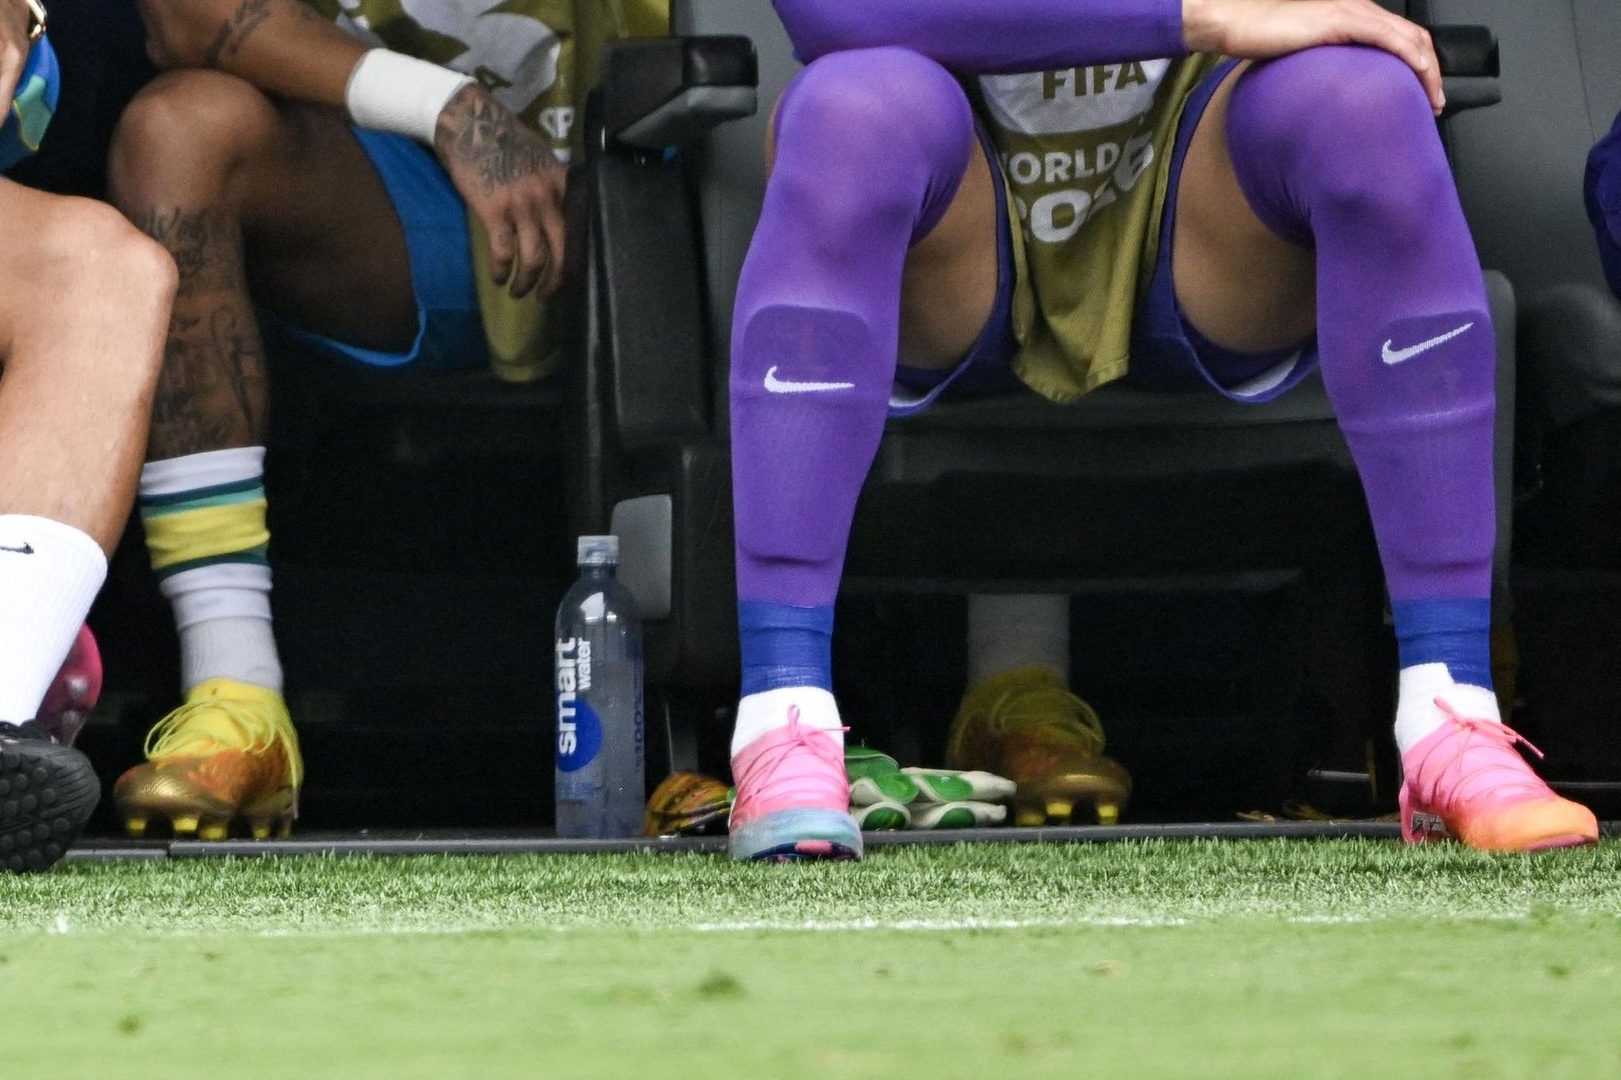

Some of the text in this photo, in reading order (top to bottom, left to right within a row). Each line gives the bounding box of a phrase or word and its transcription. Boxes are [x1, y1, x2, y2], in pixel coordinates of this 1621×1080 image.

[1042, 61, 1148, 100] FIFA
[1001, 141, 1121, 184] ORLD
[577, 637, 593, 691] water
[555, 637, 578, 756] smart
